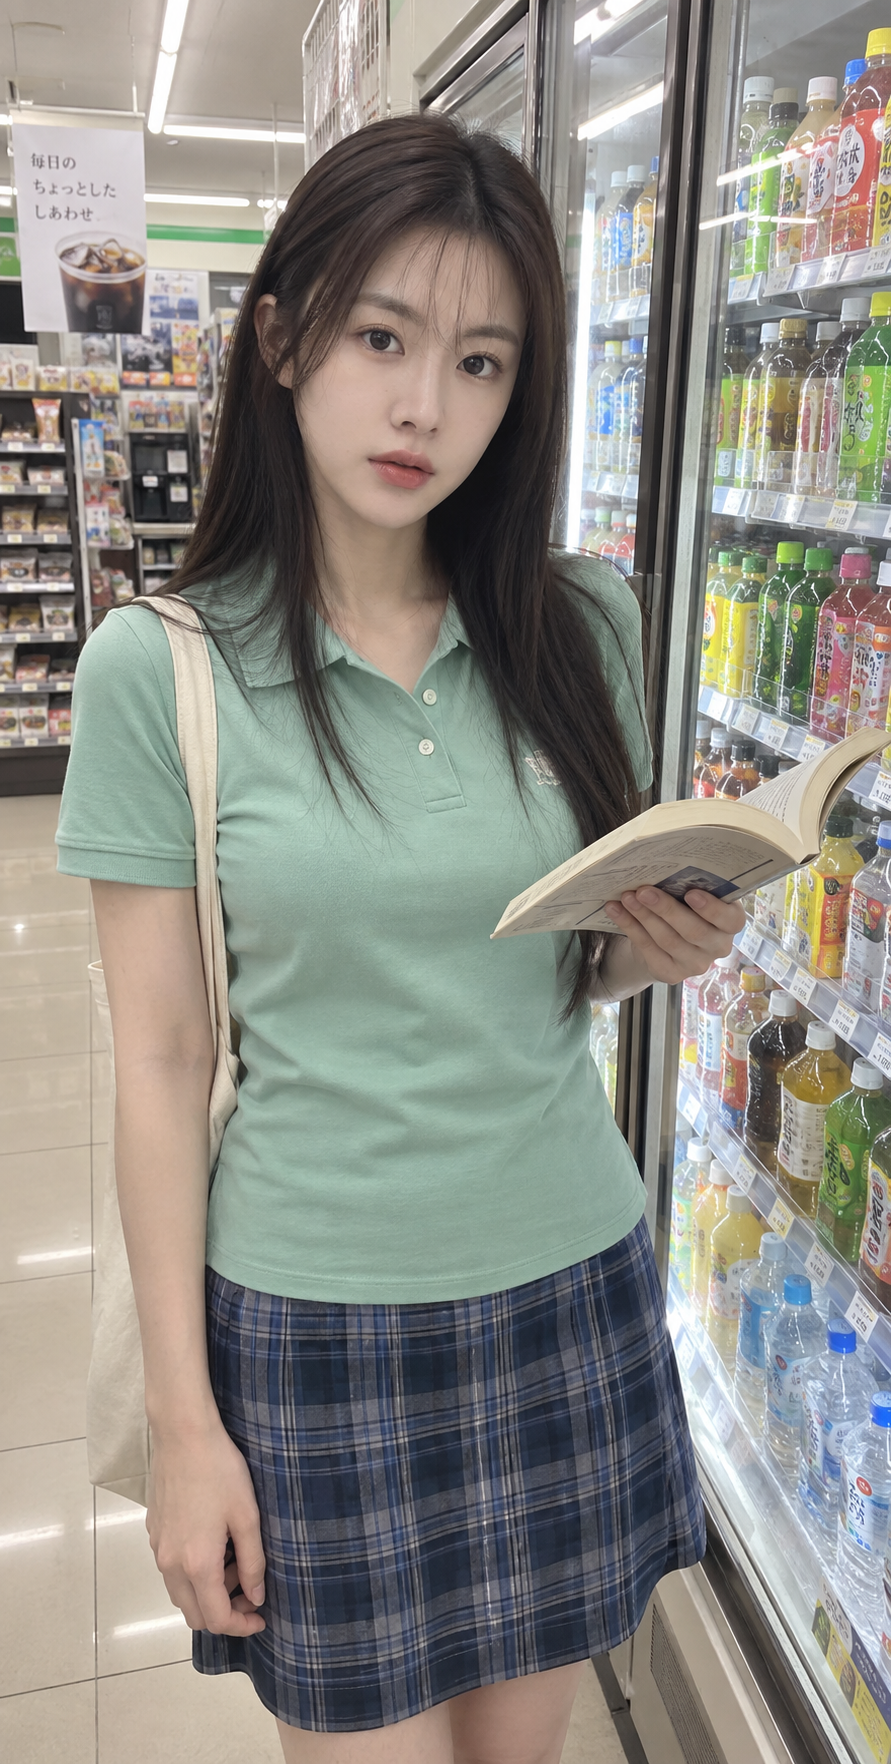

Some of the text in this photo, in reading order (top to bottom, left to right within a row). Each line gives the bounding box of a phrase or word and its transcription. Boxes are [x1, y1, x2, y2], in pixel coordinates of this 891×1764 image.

[31, 153, 76, 170] 毎日の
[33, 179, 116, 198] ちょっとした
